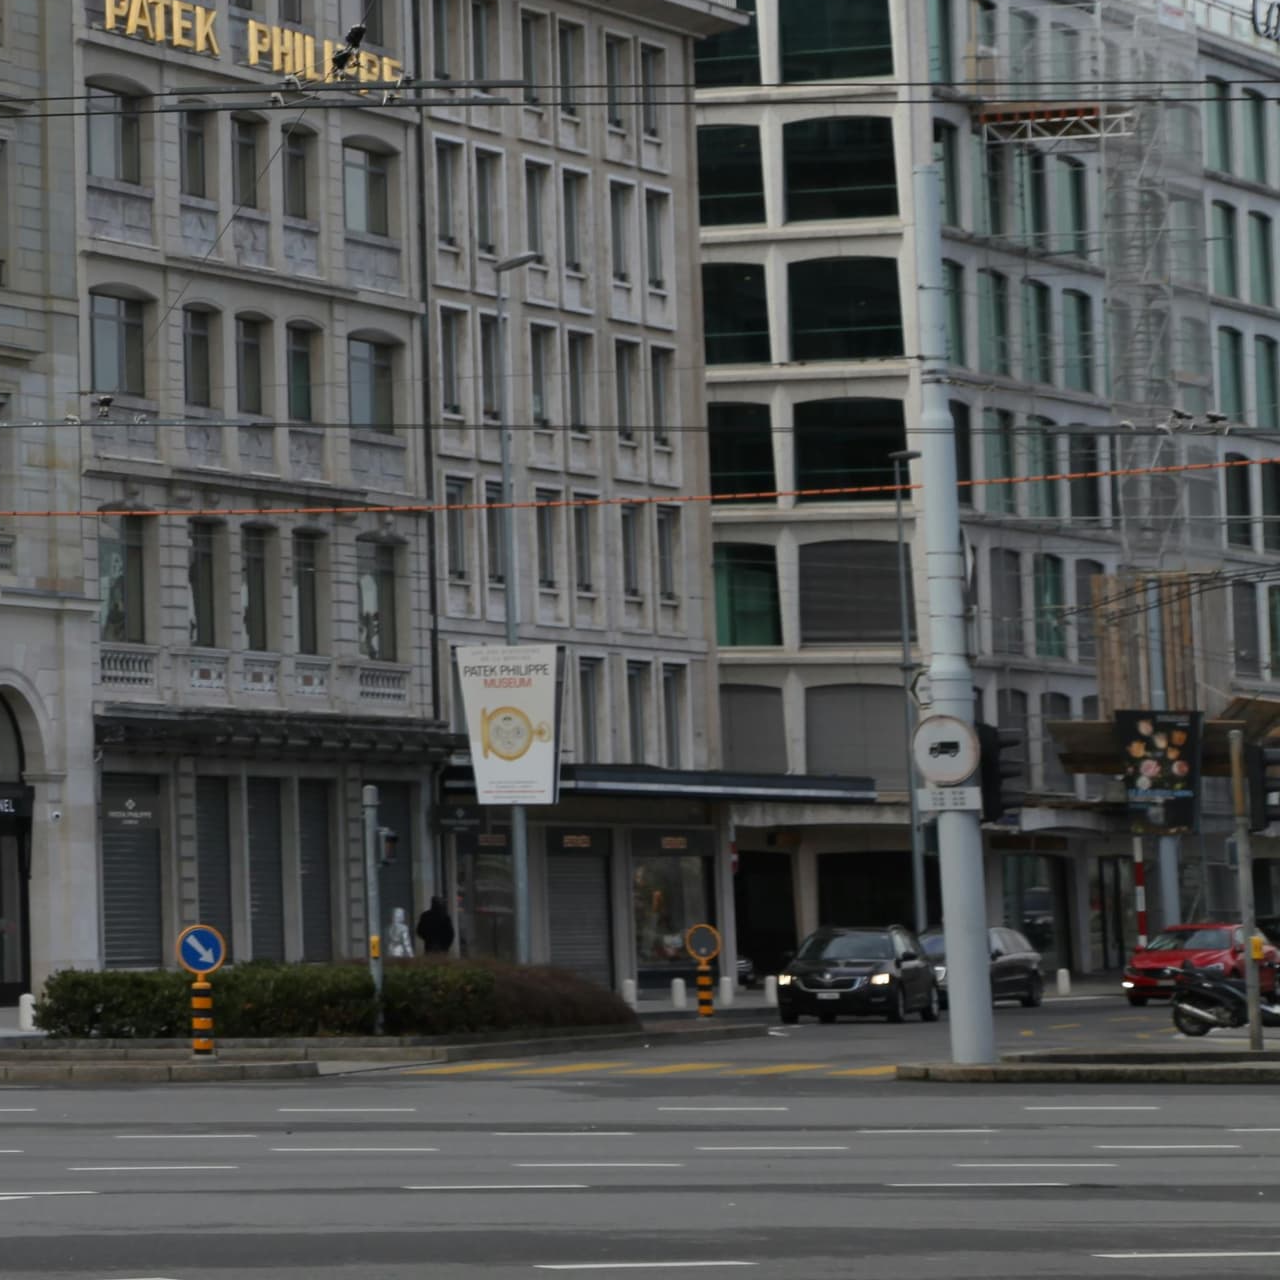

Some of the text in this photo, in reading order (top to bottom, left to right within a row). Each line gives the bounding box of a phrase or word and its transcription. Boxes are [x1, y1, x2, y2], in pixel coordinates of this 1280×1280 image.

[248, 19, 403, 96] PHILIPE
[463, 663, 550, 677] PATEK PHILIPPE
[483, 678, 533, 688] MUSEUM
